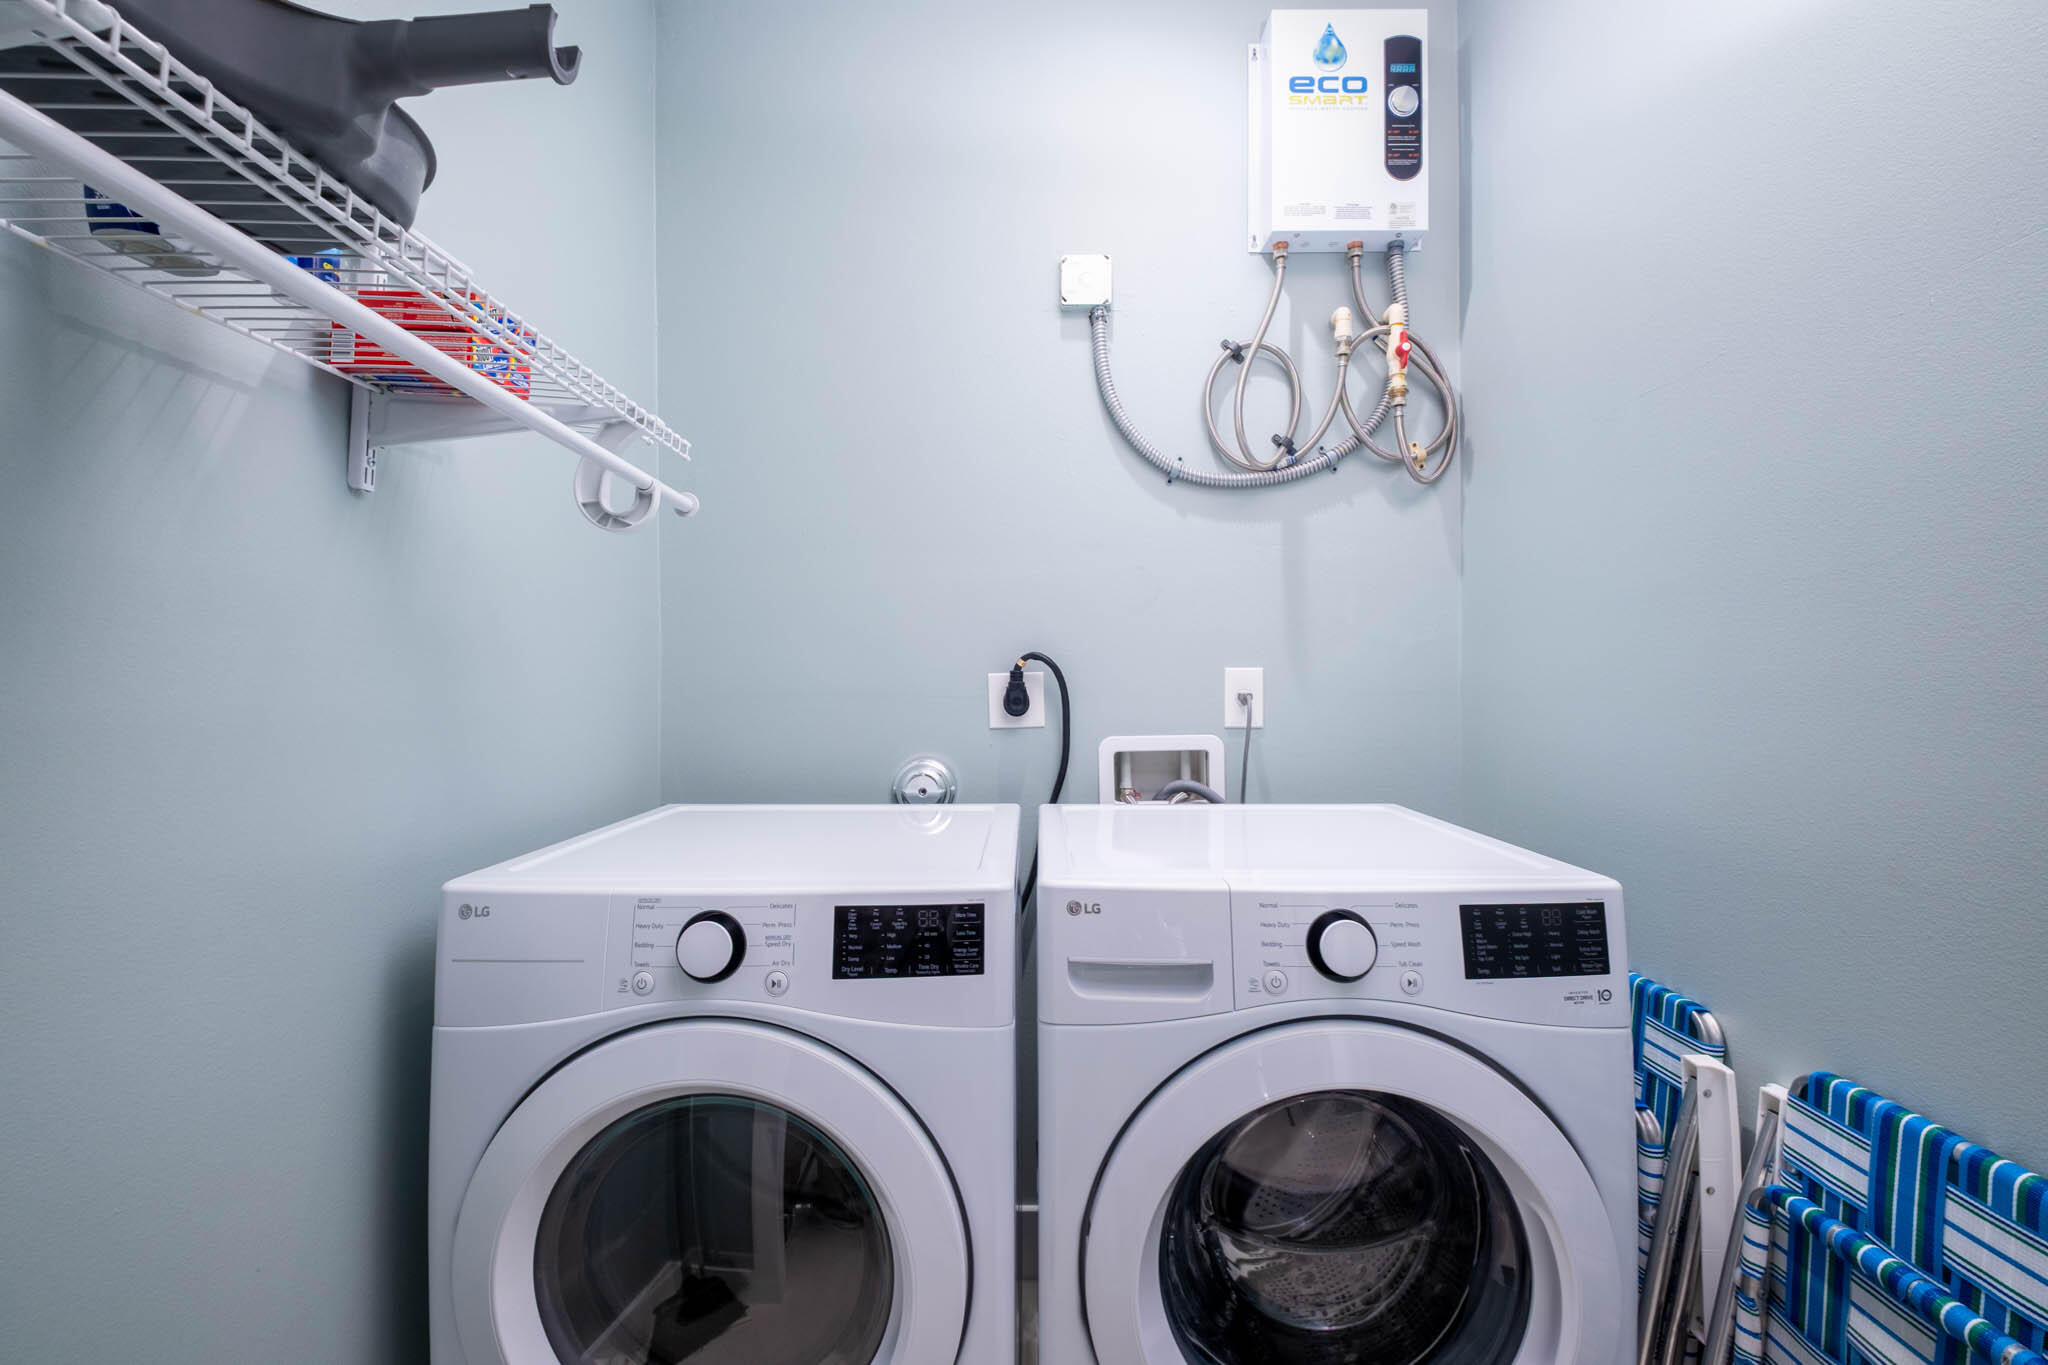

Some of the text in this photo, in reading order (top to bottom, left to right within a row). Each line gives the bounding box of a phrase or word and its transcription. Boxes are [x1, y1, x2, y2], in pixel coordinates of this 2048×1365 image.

[1289, 76, 1368, 93] eco
[474, 905, 490, 918] LG
[1084, 903, 1101, 915] LG
[635, 922, 664, 930] Heavy Duty
[1260, 921, 1290, 929] Heavy Duty
[634, 941, 655, 950] Bedding
[781, 940, 791, 949] Dry
[1261, 941, 1283, 949] Bedding
